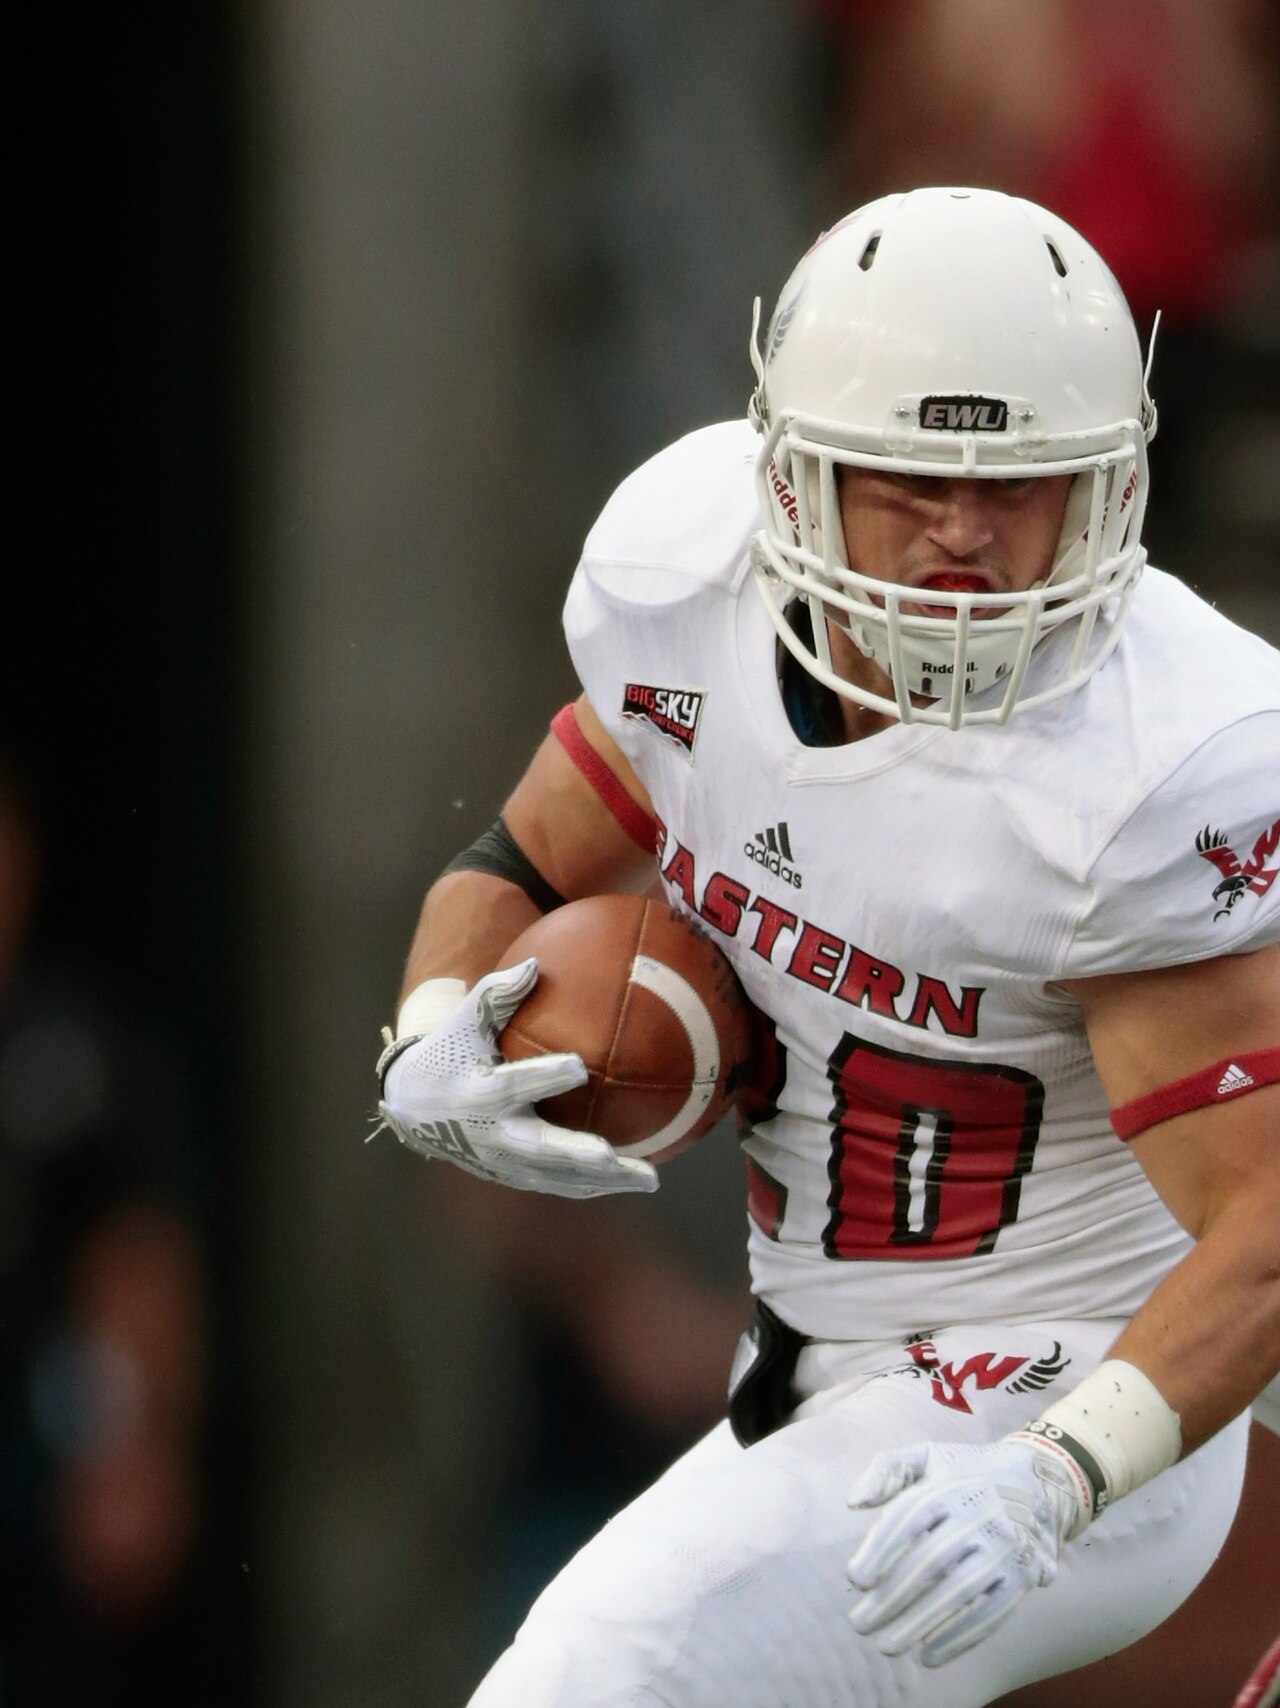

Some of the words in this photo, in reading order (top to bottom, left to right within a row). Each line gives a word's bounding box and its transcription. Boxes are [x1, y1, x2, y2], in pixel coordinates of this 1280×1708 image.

[923, 403, 1006, 429] EWU
[744, 842, 802, 890] adidas
[1217, 1075, 1255, 1095] adidas
